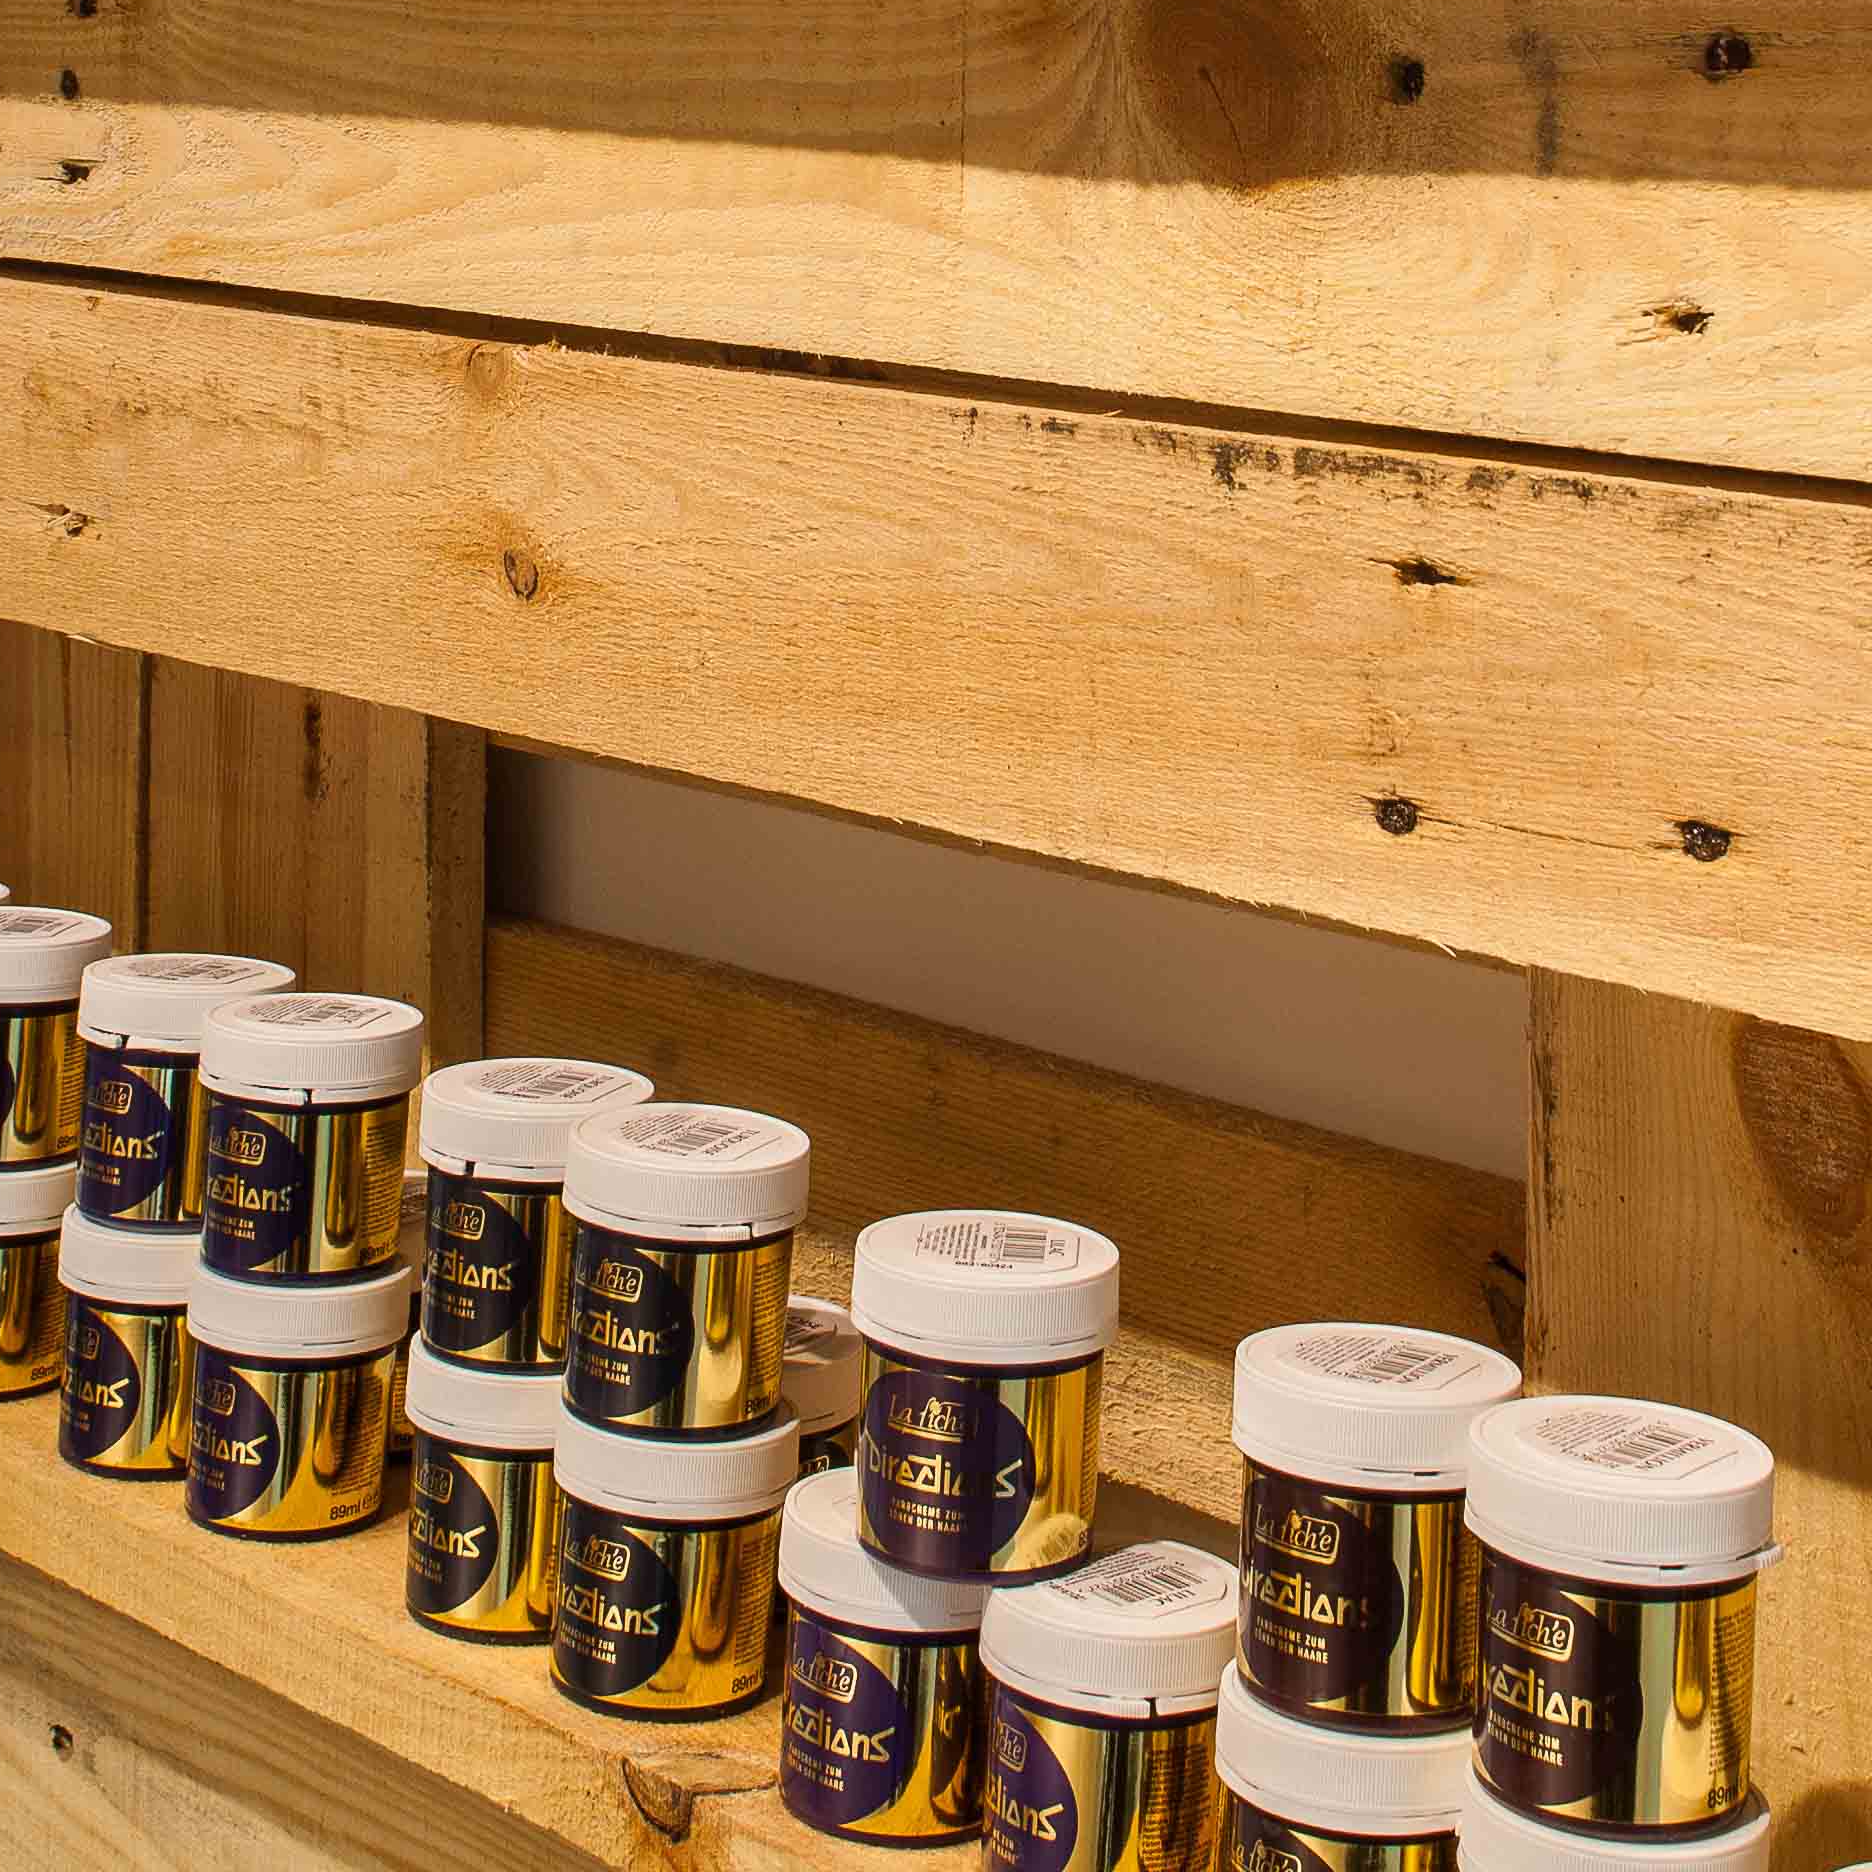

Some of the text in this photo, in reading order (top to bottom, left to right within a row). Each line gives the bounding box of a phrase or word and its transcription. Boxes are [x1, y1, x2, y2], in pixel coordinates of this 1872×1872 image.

[330, 1500, 361, 1521] 89ml
[1305, 1630, 1326, 1649] ZUM
[1538, 1731, 1561, 1750] ZUM
